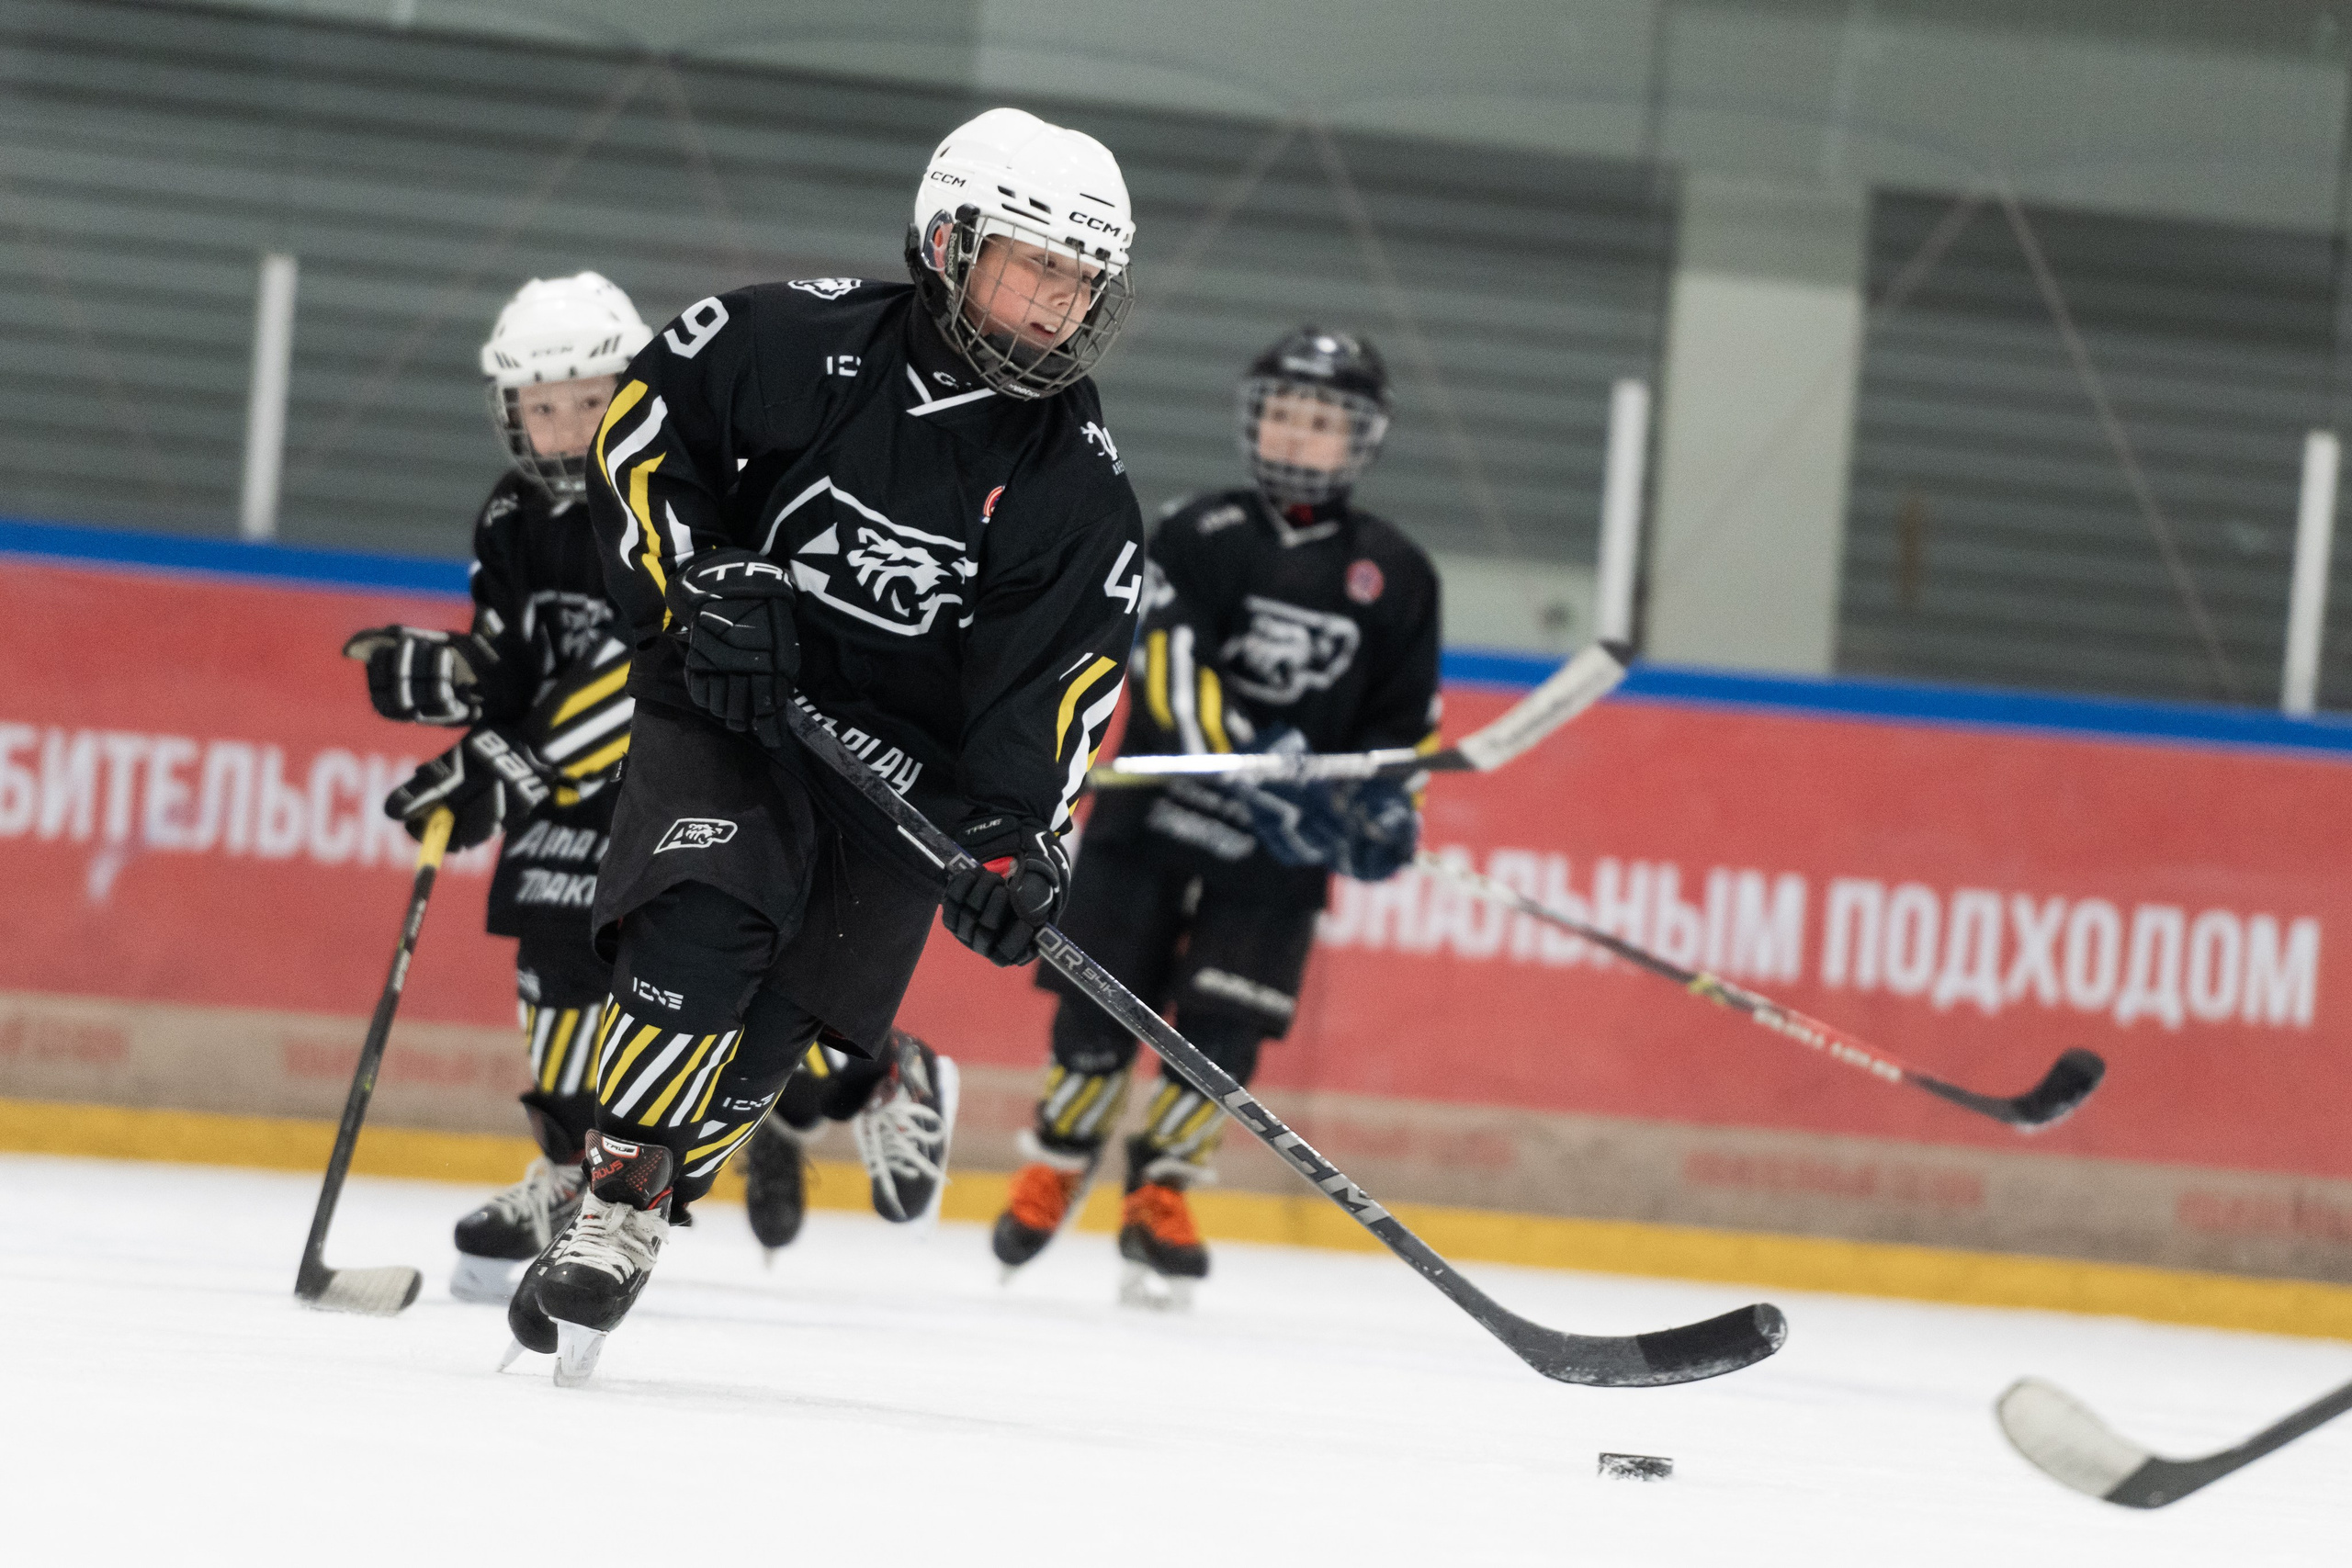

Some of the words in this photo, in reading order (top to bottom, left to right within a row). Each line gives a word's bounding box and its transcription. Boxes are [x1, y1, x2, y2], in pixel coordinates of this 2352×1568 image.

[930, 171, 967, 188] CCM
[1069, 211, 1122, 237] CCM
[946, 232, 958, 275] Reebok
[697, 561, 794, 589] TR
[965, 818, 1002, 835] TRUE
[0, 720, 496, 874] БИТЕЛЬСК
[1822, 875, 2321, 1031] ПОДХОДОМ
[1035, 926, 1084, 971] OR
[605, 1140, 635, 1154] TRUE
[1223, 1088, 1391, 1226] CCM
